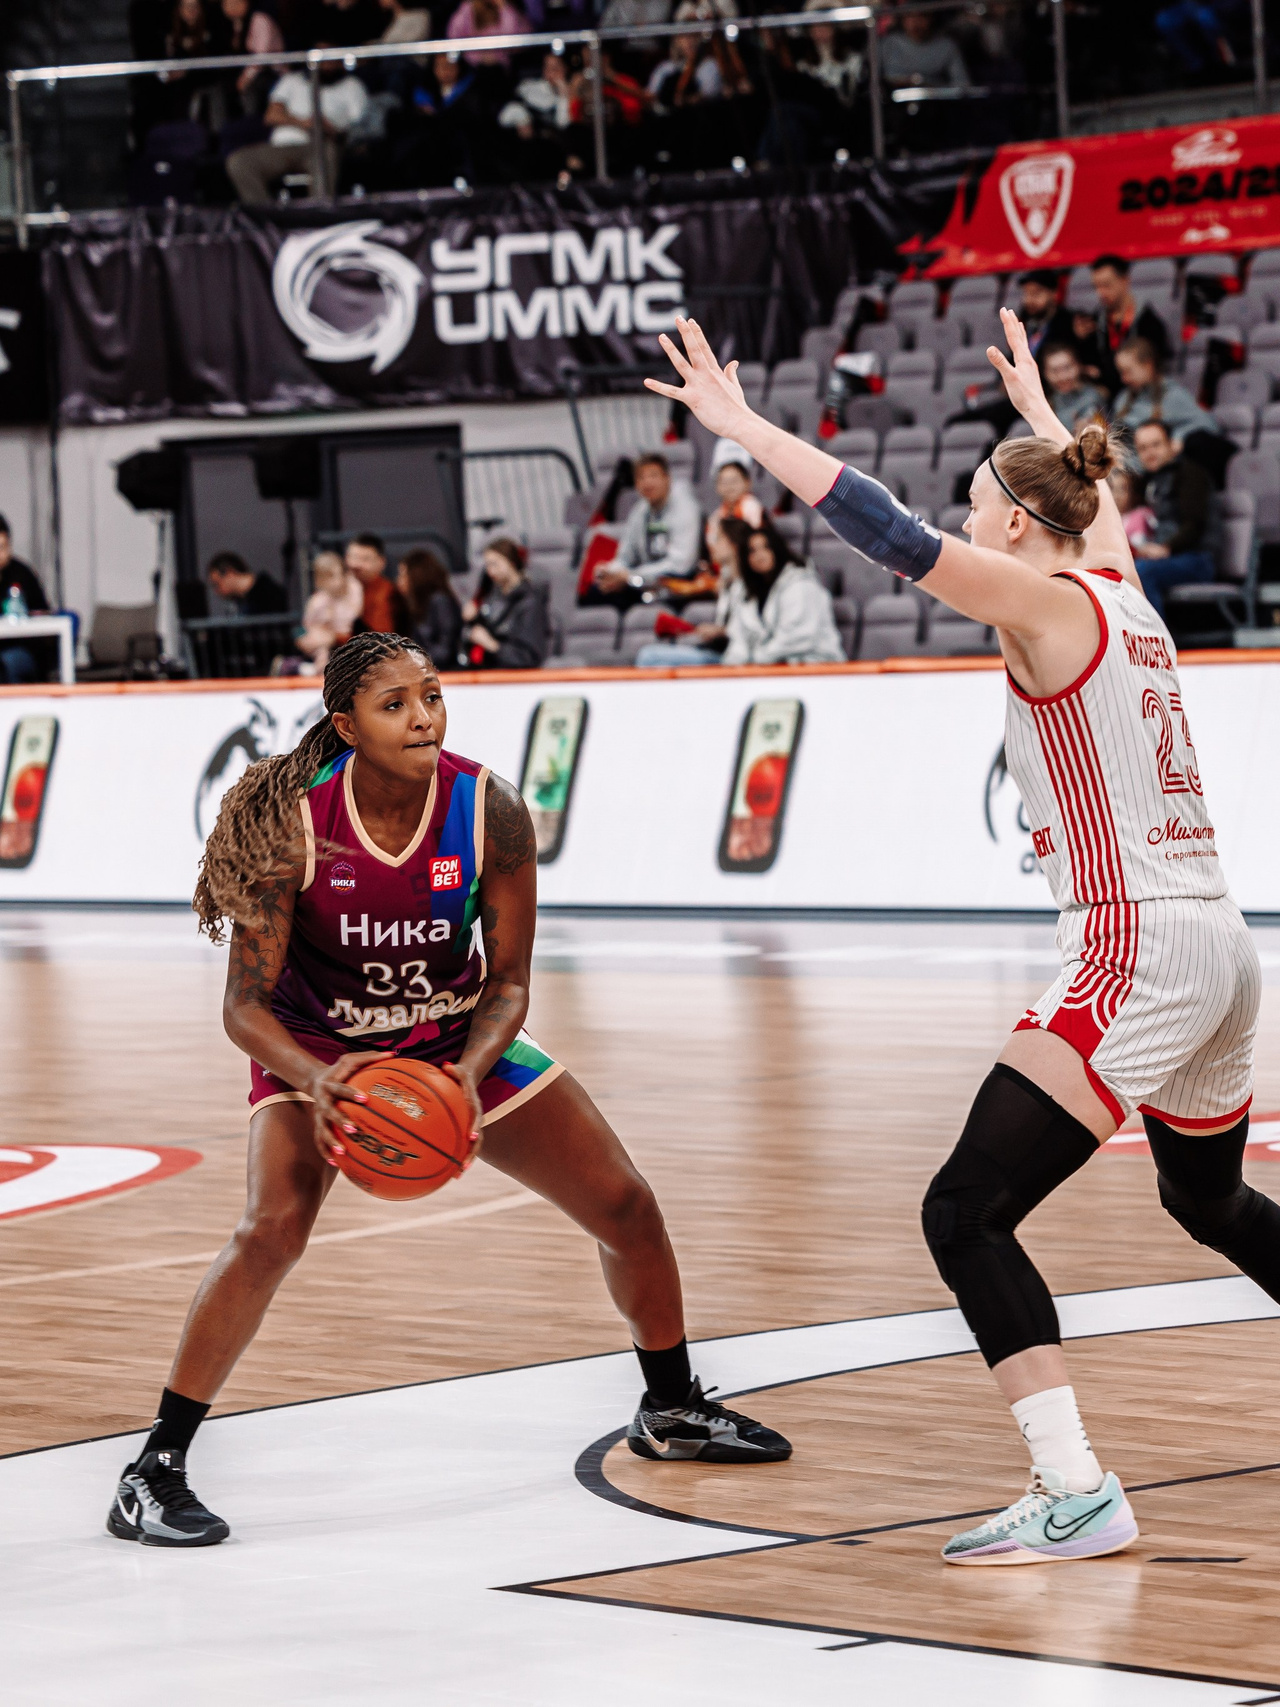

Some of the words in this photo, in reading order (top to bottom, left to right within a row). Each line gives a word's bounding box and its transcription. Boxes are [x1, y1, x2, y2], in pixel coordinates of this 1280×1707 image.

[430, 223, 685, 293] УГМК
[433, 280, 689, 345] UMMC
[331, 879, 356, 888] НИКА
[431, 858, 459, 874] FON
[433, 873, 460, 887] BET
[340, 913, 451, 948] Ника
[362, 959, 434, 999] 33
